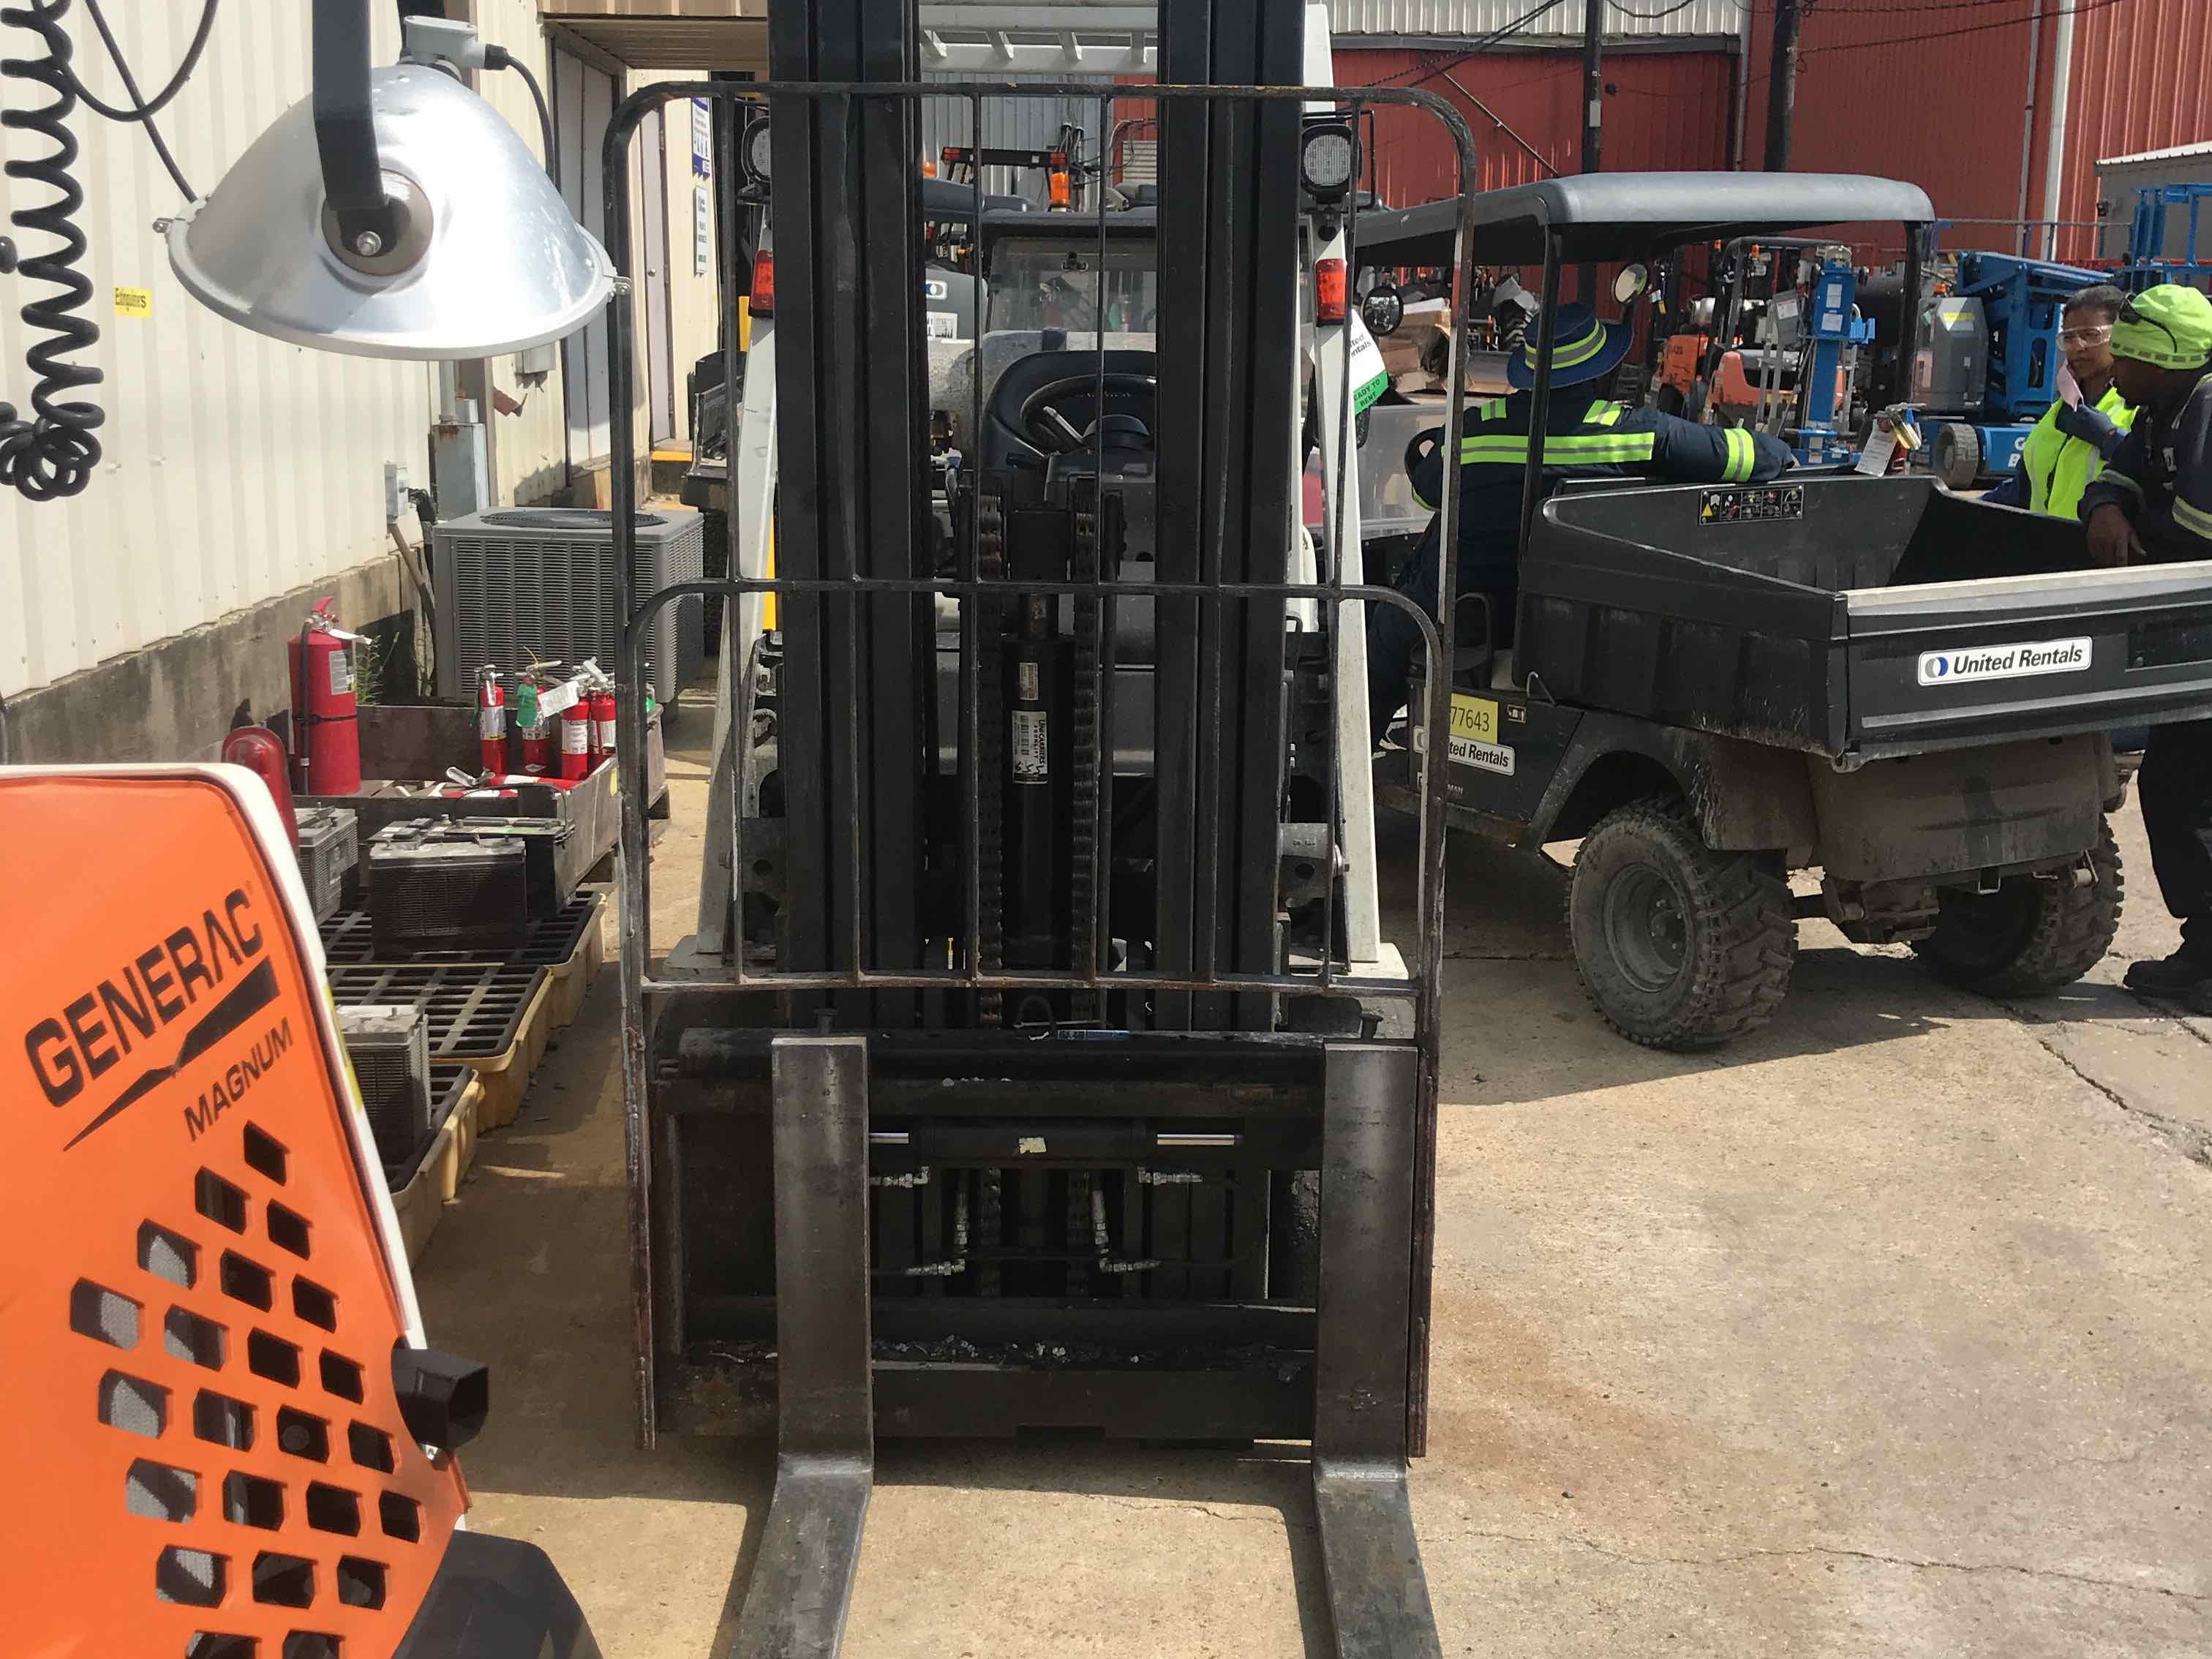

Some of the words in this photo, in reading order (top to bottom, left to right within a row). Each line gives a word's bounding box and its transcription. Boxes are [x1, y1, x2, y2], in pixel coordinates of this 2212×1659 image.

[1350, 333, 1364, 347] ted
[1350, 341, 1372, 357] ntals
[1354, 385, 1370, 401] EADY
[1371, 378, 1380, 388] TO
[1361, 391, 1375, 407] RENT
[1953, 650, 2014, 674] United
[2019, 642, 2083, 668] Rentals
[1449, 741, 1466, 758] ted
[1468, 744, 1510, 767] Rentals
[24, 887, 264, 1108] GENERAC
[183, 1016, 293, 1141] MAGNUM
